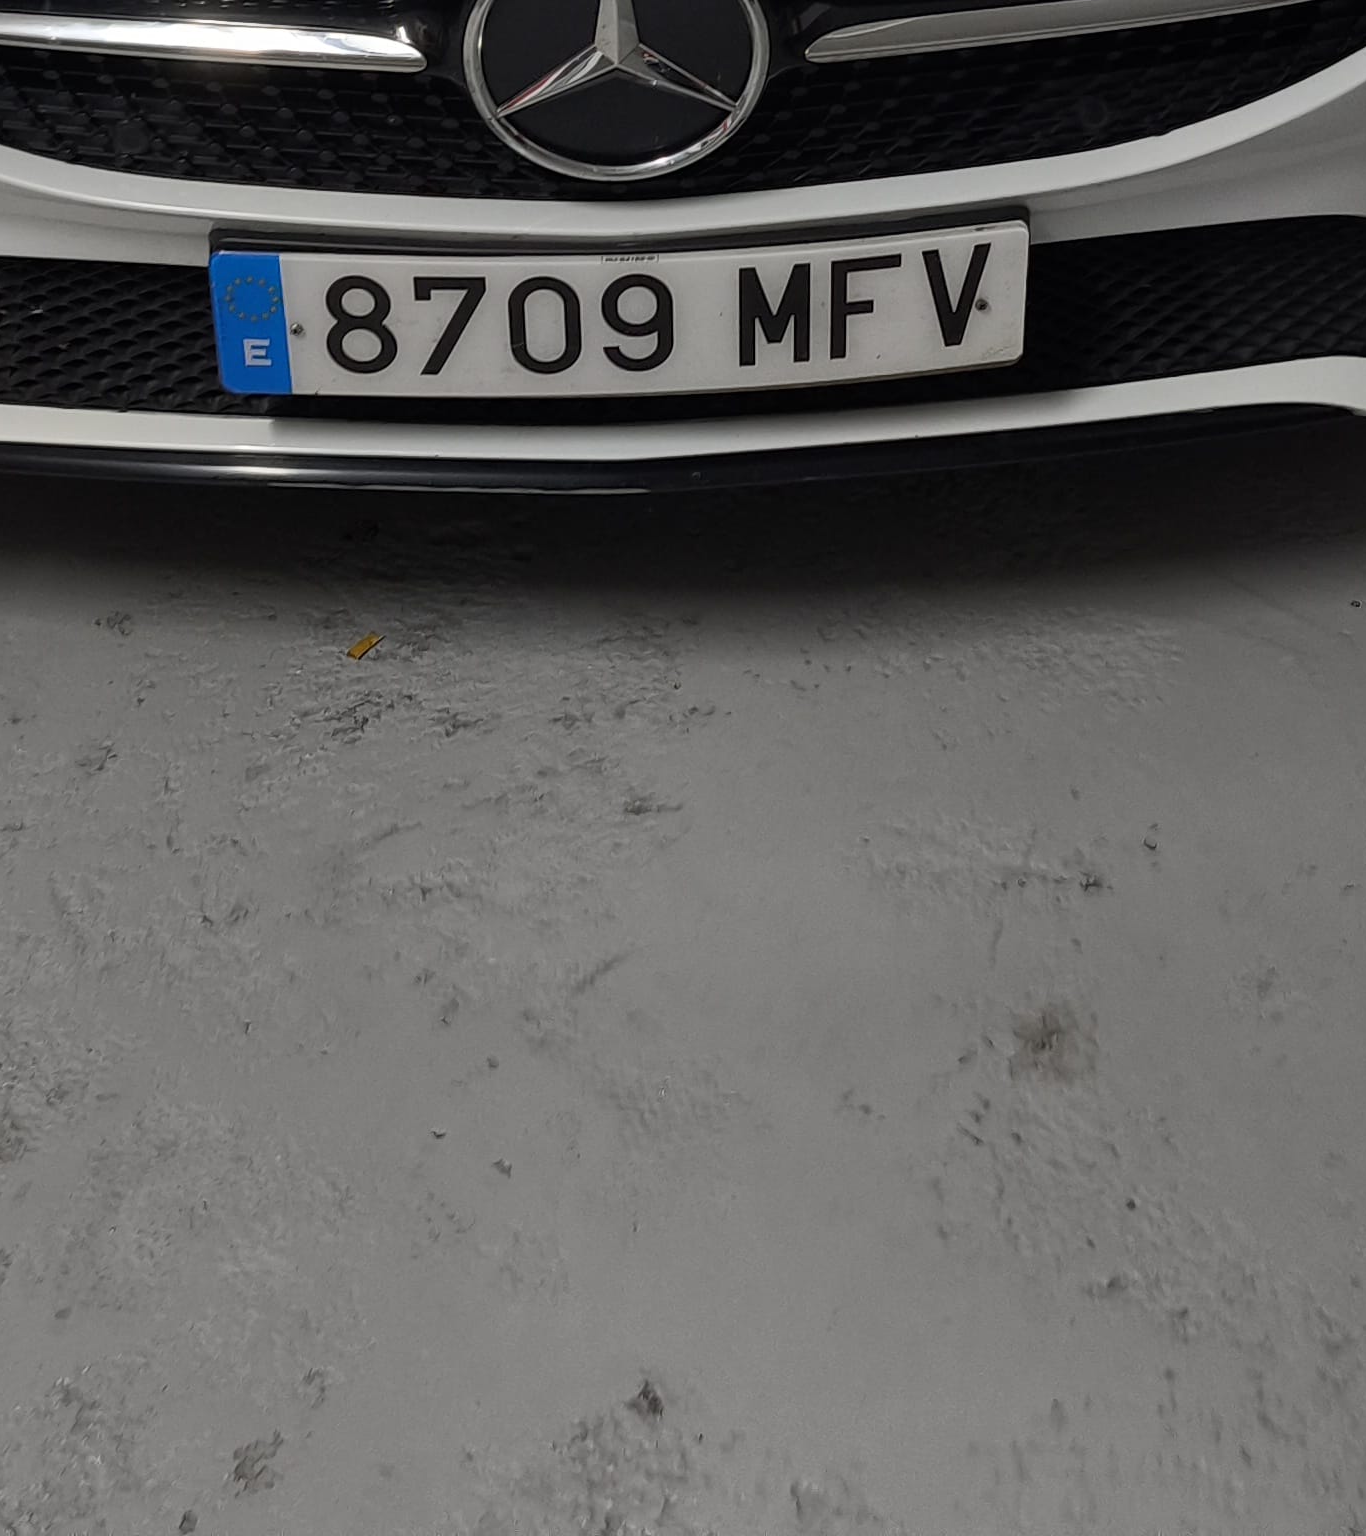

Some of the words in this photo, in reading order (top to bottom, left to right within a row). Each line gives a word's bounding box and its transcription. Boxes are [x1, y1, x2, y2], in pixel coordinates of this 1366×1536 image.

[325, 274, 674, 376] 8709
[739, 242, 992, 367] MFV
[243, 339, 272, 367] E
